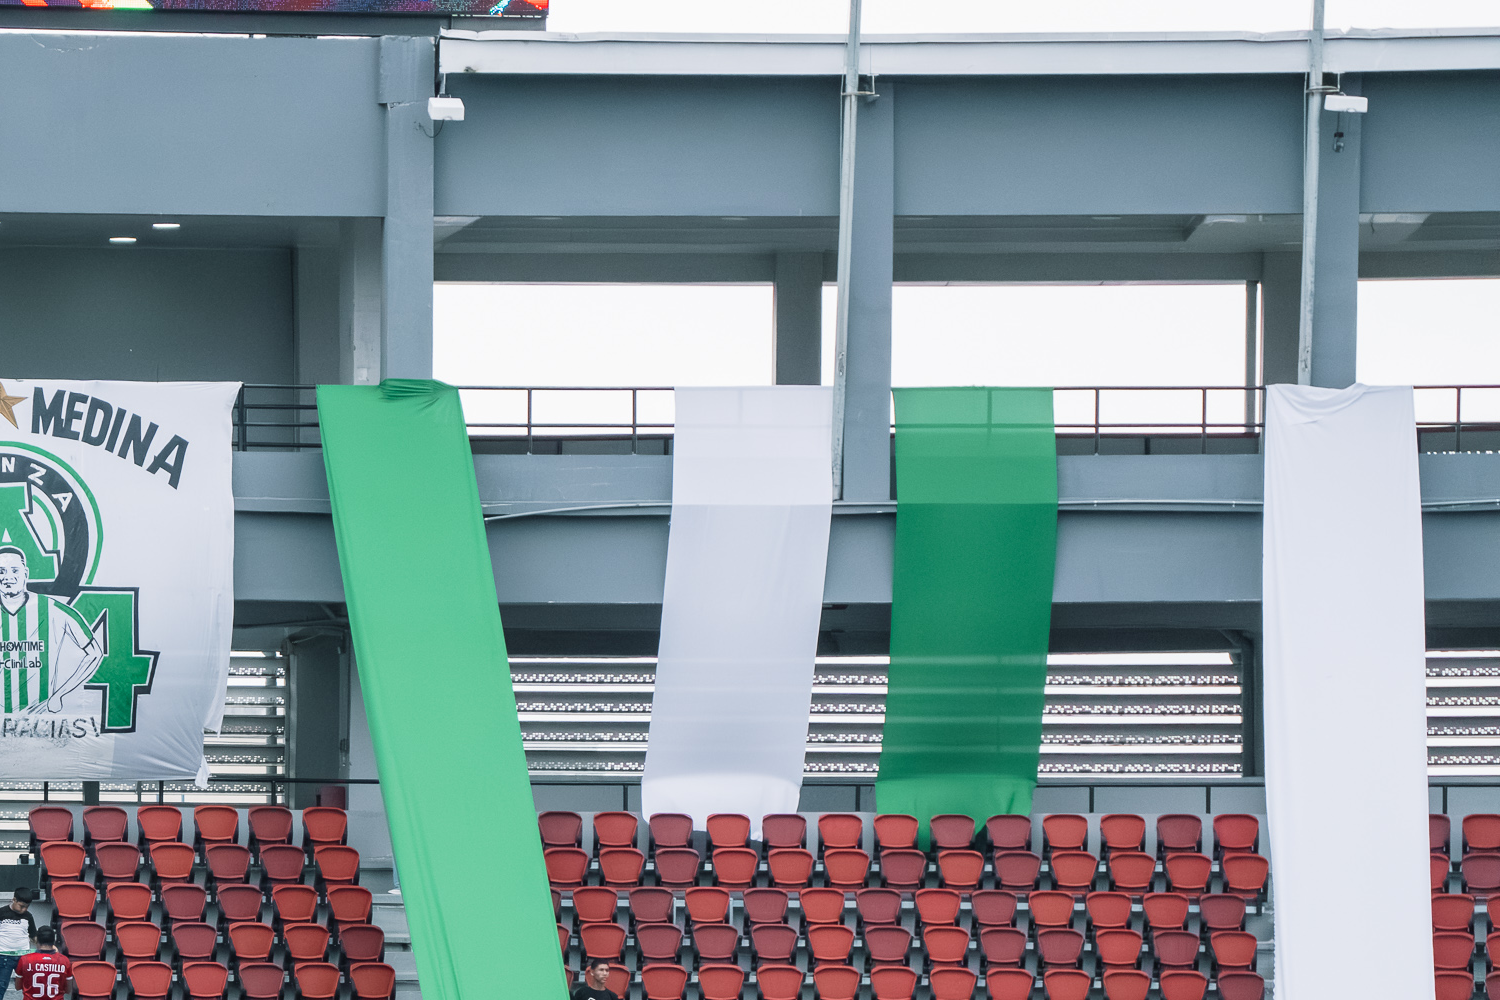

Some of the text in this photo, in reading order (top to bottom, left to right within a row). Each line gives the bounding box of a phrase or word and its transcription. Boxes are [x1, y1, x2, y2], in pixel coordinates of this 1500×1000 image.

[31, 387, 190, 490] MEDINA
[35, 963, 66, 973] CASTILLO
[32, 972, 60, 998] 56
